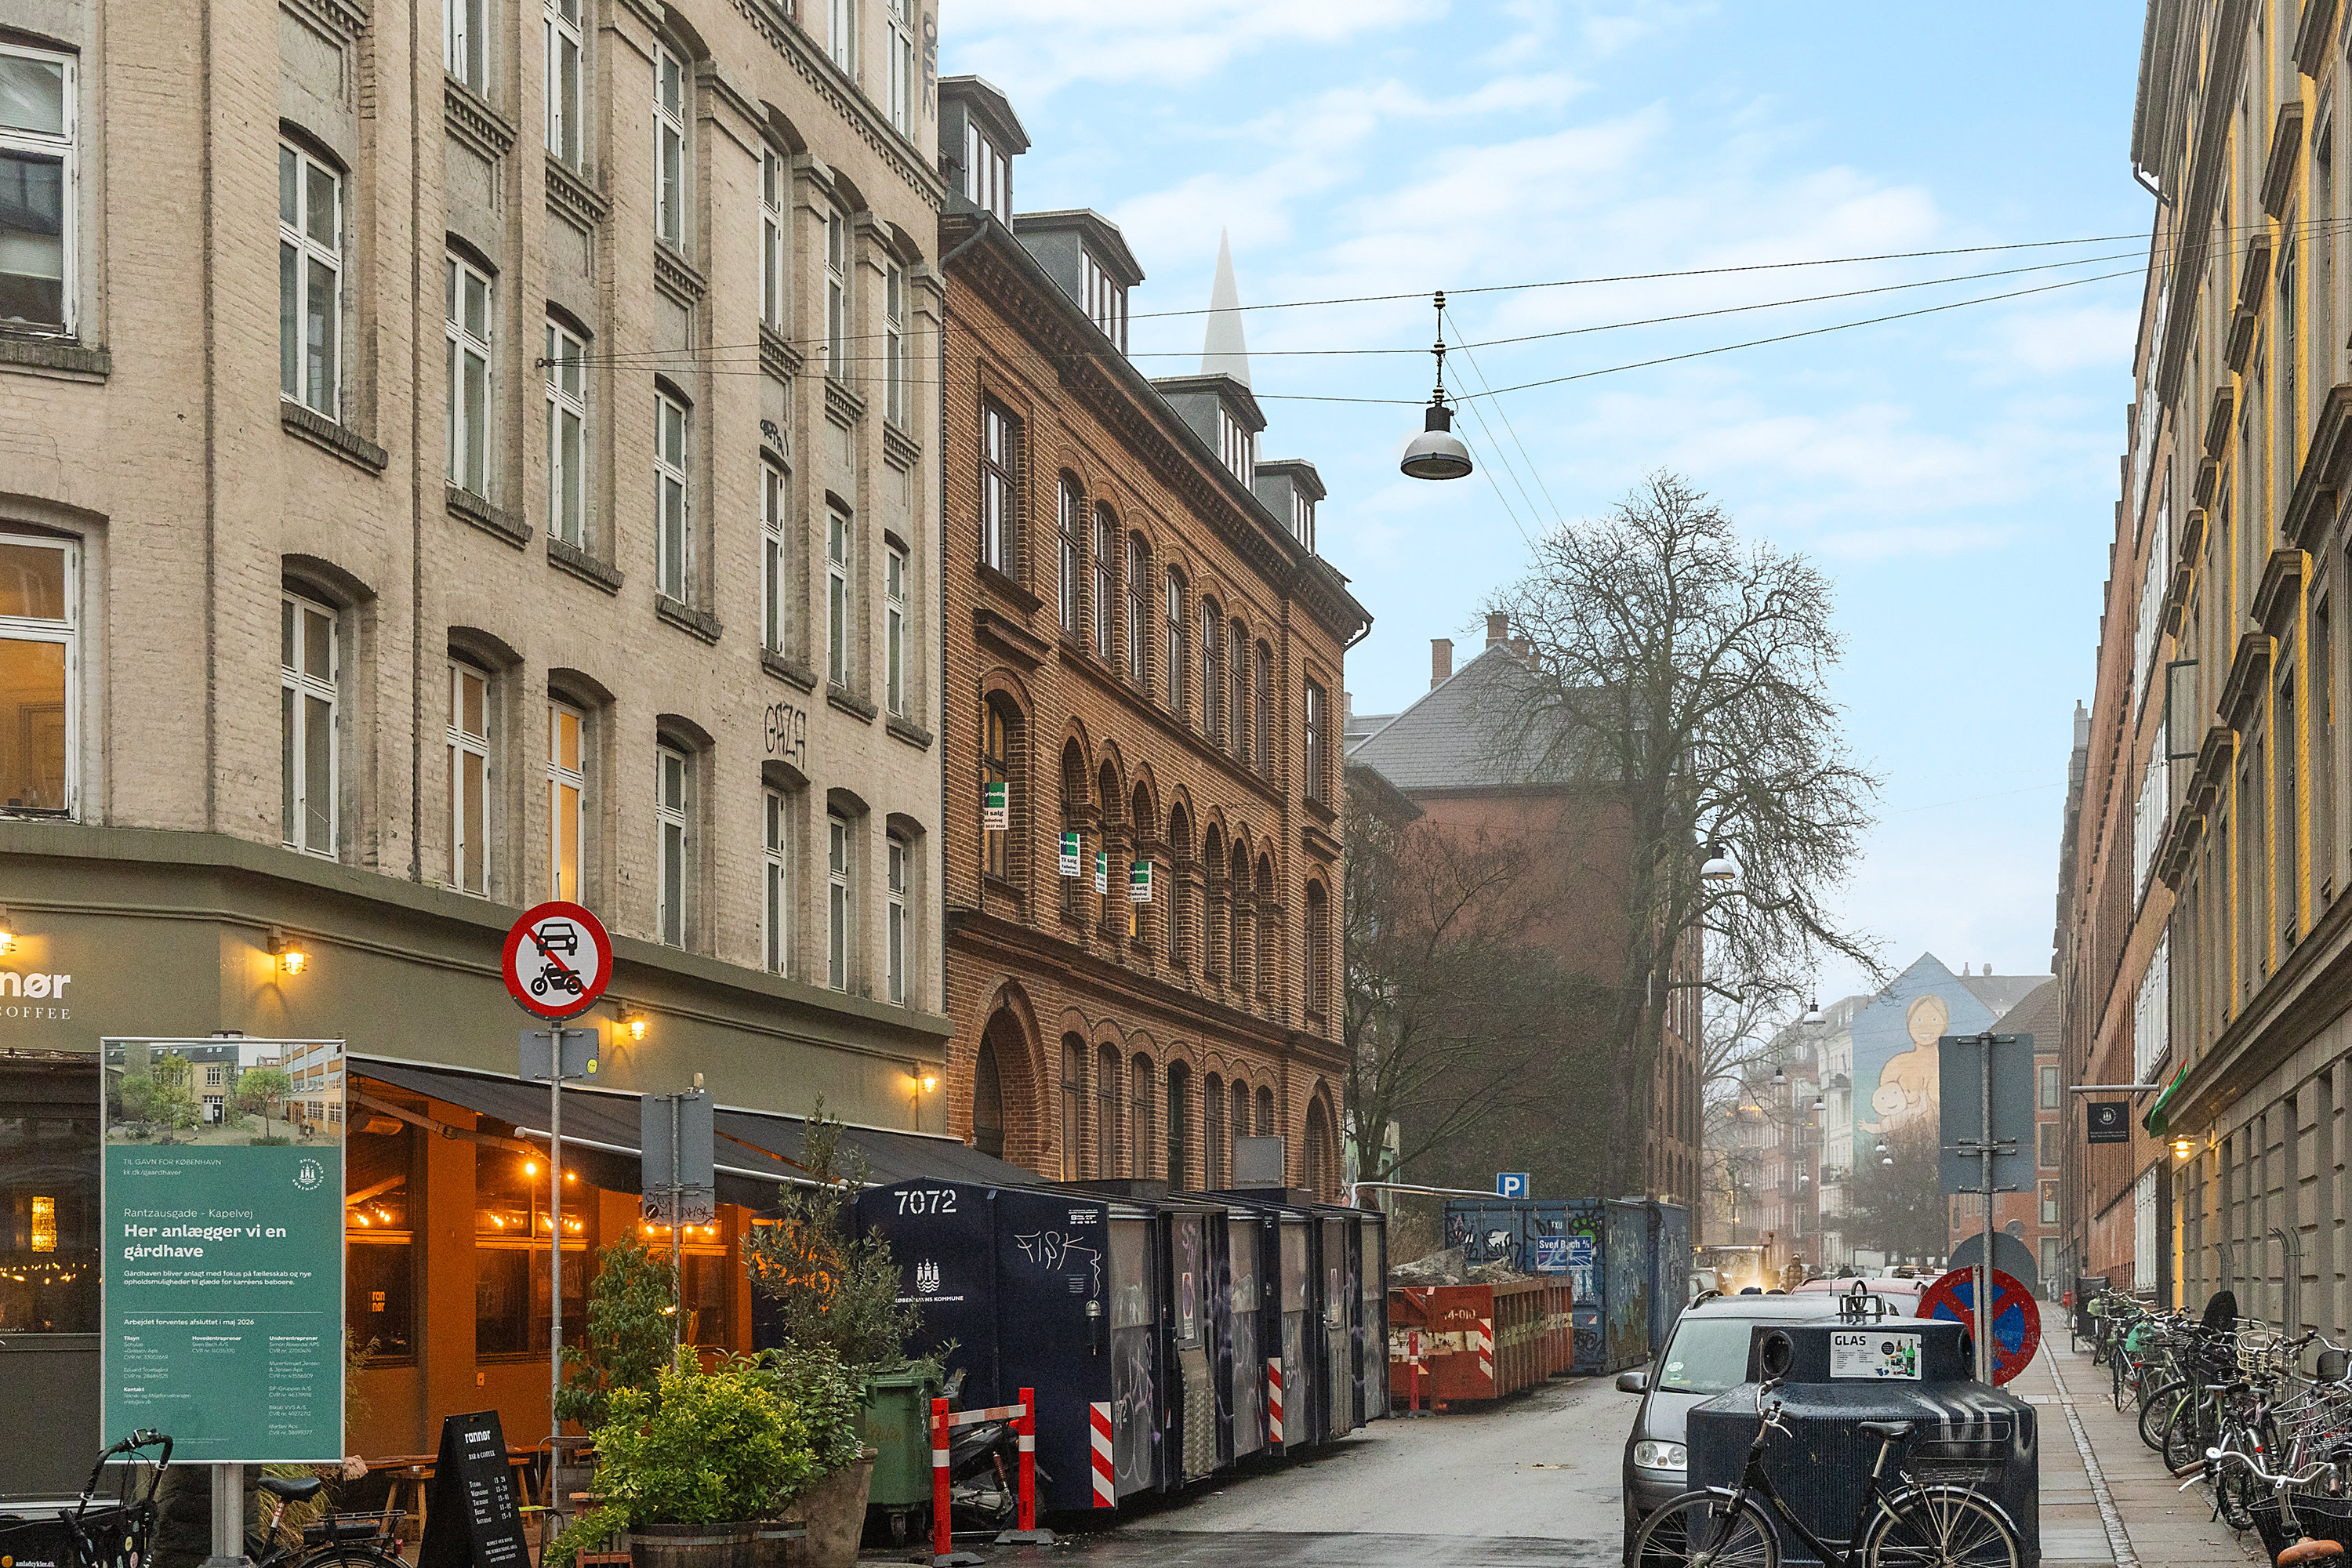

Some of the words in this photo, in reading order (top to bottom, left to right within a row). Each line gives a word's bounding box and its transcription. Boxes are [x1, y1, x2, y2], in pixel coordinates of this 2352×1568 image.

[765, 702, 806, 769] GAZA
[0, 1006, 71, 1020] OFFEE
[1504, 1177, 1520, 1197] P
[895, 1189, 956, 1214] 7072
[124, 1208, 198, 1220] Rantzausgade
[209, 1208, 253, 1220] Kapelvej
[125, 1225, 158, 1237] Her
[162, 1225, 241, 1241] anlægger
[246, 1224, 261, 1237] vi
[265, 1227, 287, 1238] en
[1539, 1240, 1559, 1249] Sven
[124, 1243, 204, 1261] gårdhave
[372, 1291, 385, 1301] ran
[372, 1302, 385, 1312] nør
[1835, 1335, 1866, 1346] GLAS
[465, 1430, 491, 1443] rannør
